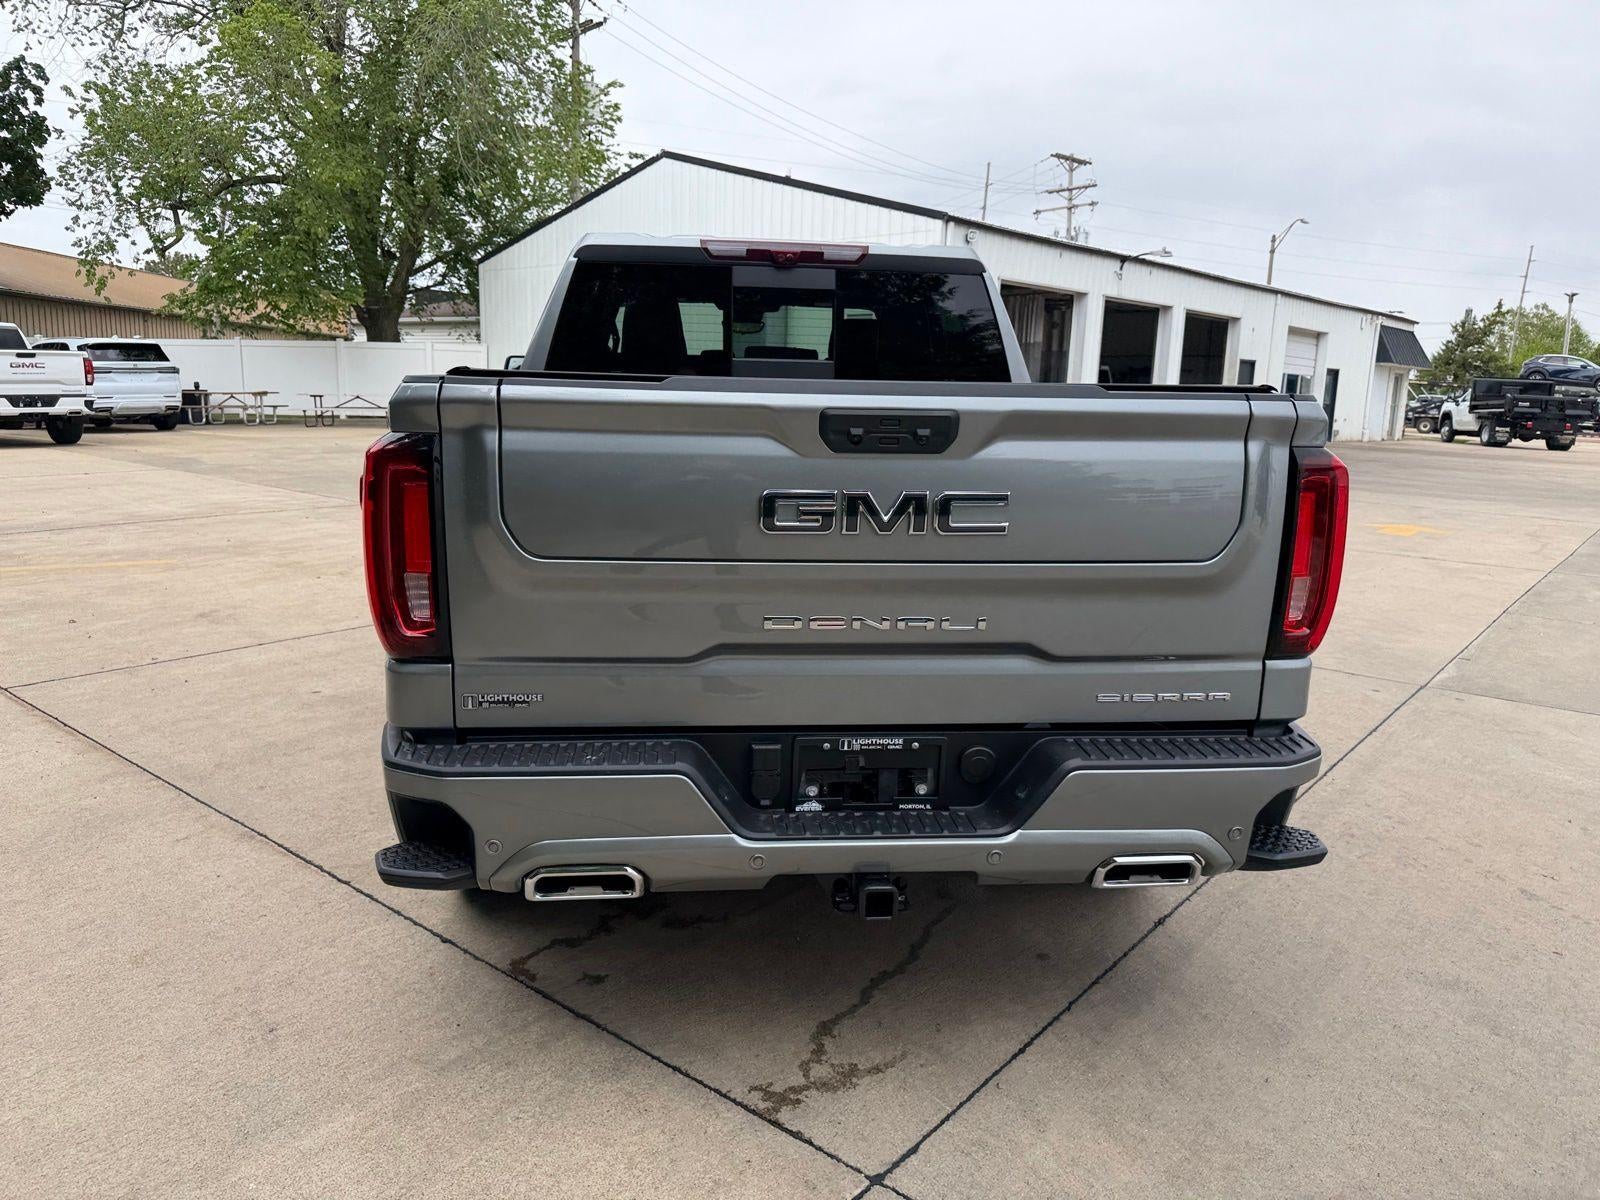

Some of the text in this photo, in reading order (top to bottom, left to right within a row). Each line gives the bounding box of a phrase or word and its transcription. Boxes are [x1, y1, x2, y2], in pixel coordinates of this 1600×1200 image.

[9, 361, 46, 369] GMC
[760, 489, 1011, 535] GMC
[763, 616, 987, 631] DENALI
[478, 694, 543, 702] LIGHTHOUSE
[1097, 692, 1232, 702] SIERRA
